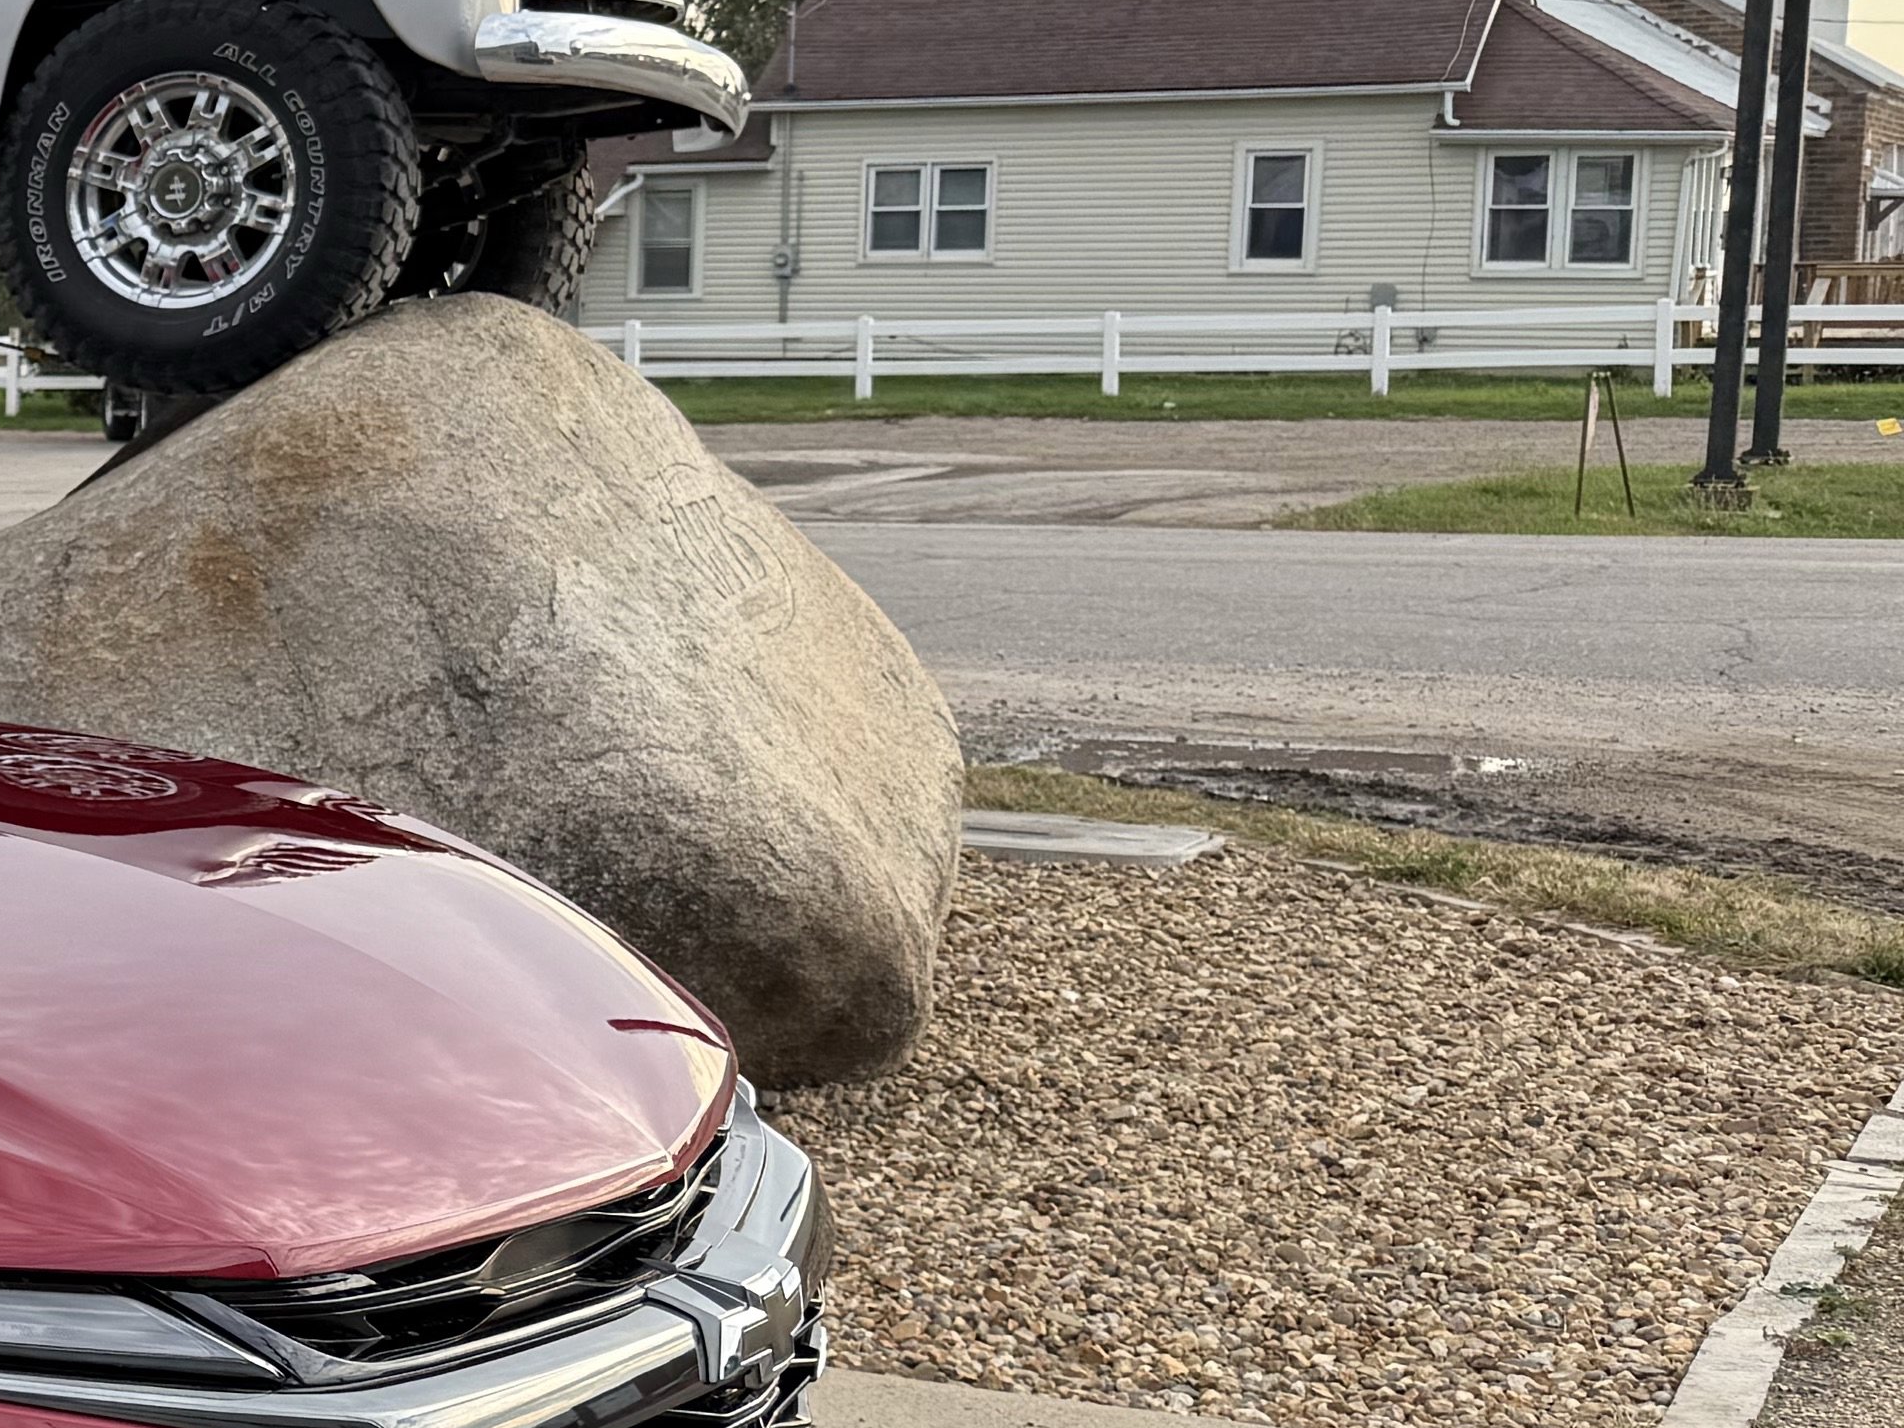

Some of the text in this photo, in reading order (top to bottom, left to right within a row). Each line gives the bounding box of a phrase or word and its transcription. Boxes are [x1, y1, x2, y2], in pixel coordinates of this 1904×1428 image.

[27, 102, 70, 283] IRONMAN
[202, 42, 326, 337] ALL COUNTRY M/T
